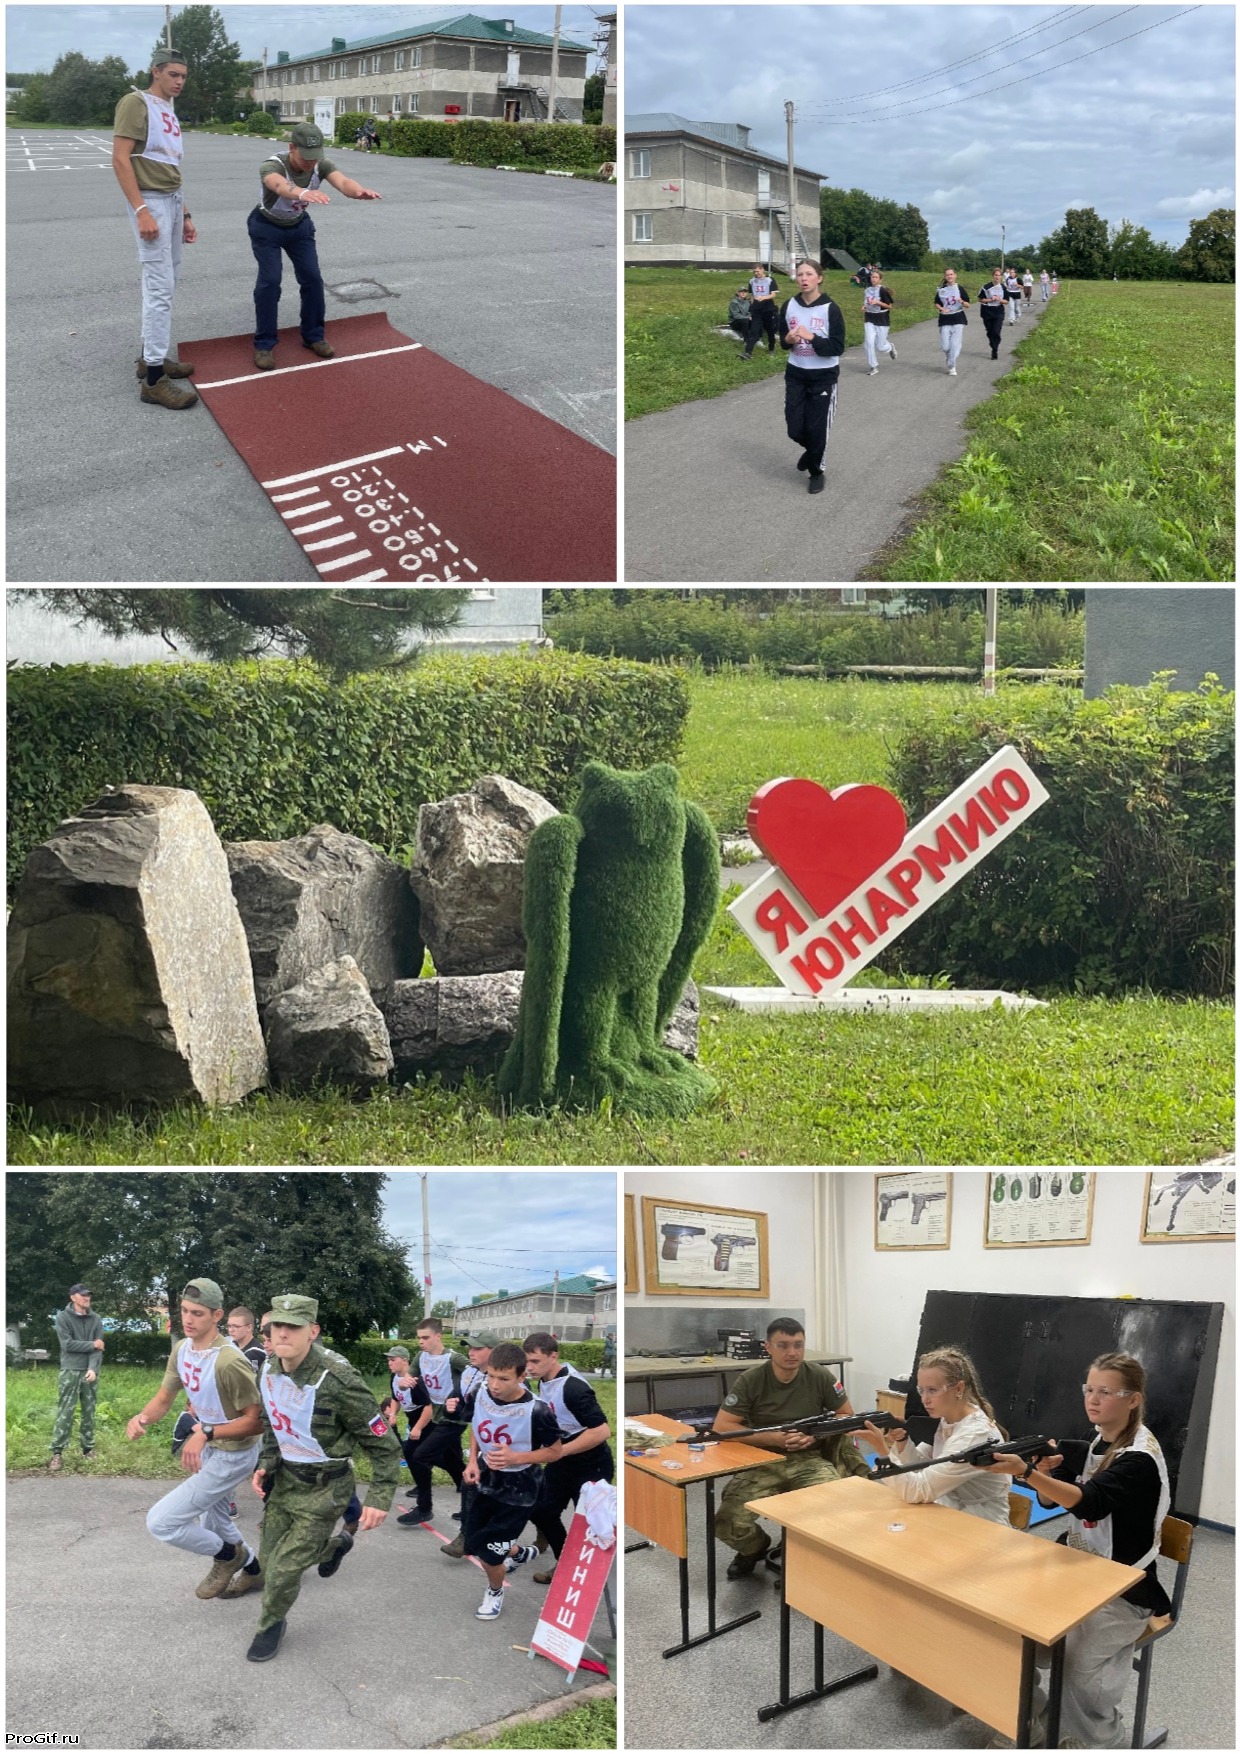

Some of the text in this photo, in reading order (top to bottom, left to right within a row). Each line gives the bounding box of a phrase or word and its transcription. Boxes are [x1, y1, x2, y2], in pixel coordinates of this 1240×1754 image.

[161, 112, 180, 137] 55
[330, 466, 382, 487] 1.10
[342, 479, 396, 502] 1.20
[355, 492, 409, 518] 1.30
[368, 507, 425, 533] 1.40
[383, 522, 441, 551] 1.50
[399, 540, 459, 571] 1.60
[790, 768, 1030, 994] ЮНАРМИЮ
[755, 889, 809, 953] Я
[423, 1373, 442, 1390] 61
[477, 1419, 512, 1446] 66
[556, 1545, 596, 1629] ИНИШ
